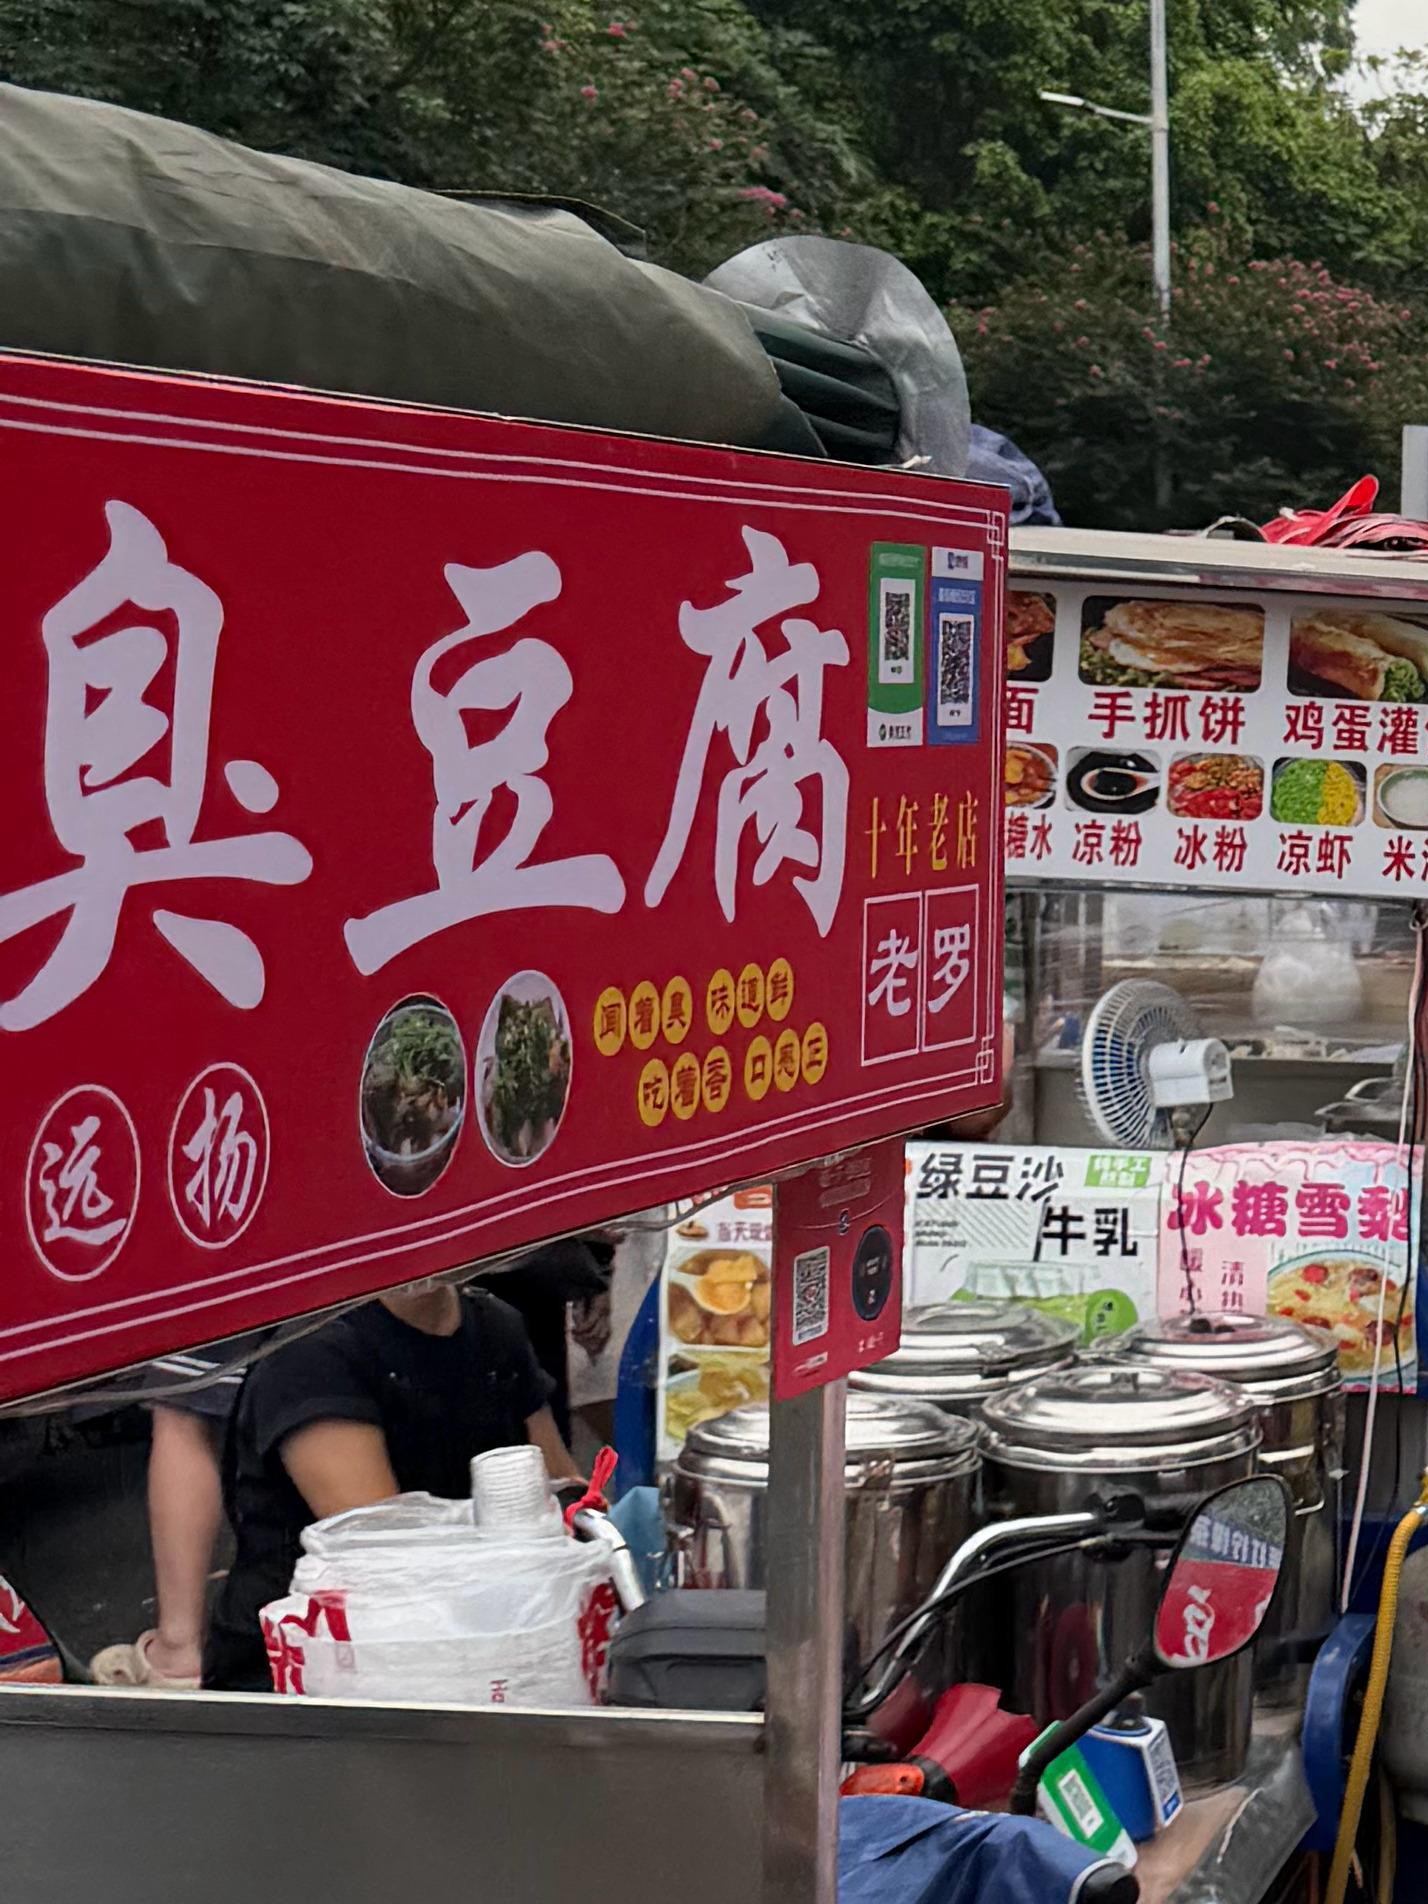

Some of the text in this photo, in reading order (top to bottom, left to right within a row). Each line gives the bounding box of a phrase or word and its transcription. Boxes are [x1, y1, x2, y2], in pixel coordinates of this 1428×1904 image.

[1088, 691, 1246, 746] 手抓饼
[0, 499, 851, 1033] 臭豆腐
[864, 788, 980, 882] 十年老店
[1072, 813, 1142, 867] 凉粉
[1173, 825, 1248, 873] 冰粉
[1277, 830, 1353, 880] 凉虾
[868, 920, 972, 1020] 老罗
[915, 1152, 1065, 1202] 绿豆沙
[1036, 1204, 1139, 1258] 牛乳
[1167, 1179, 1410, 1242] 冰糖雪梨
